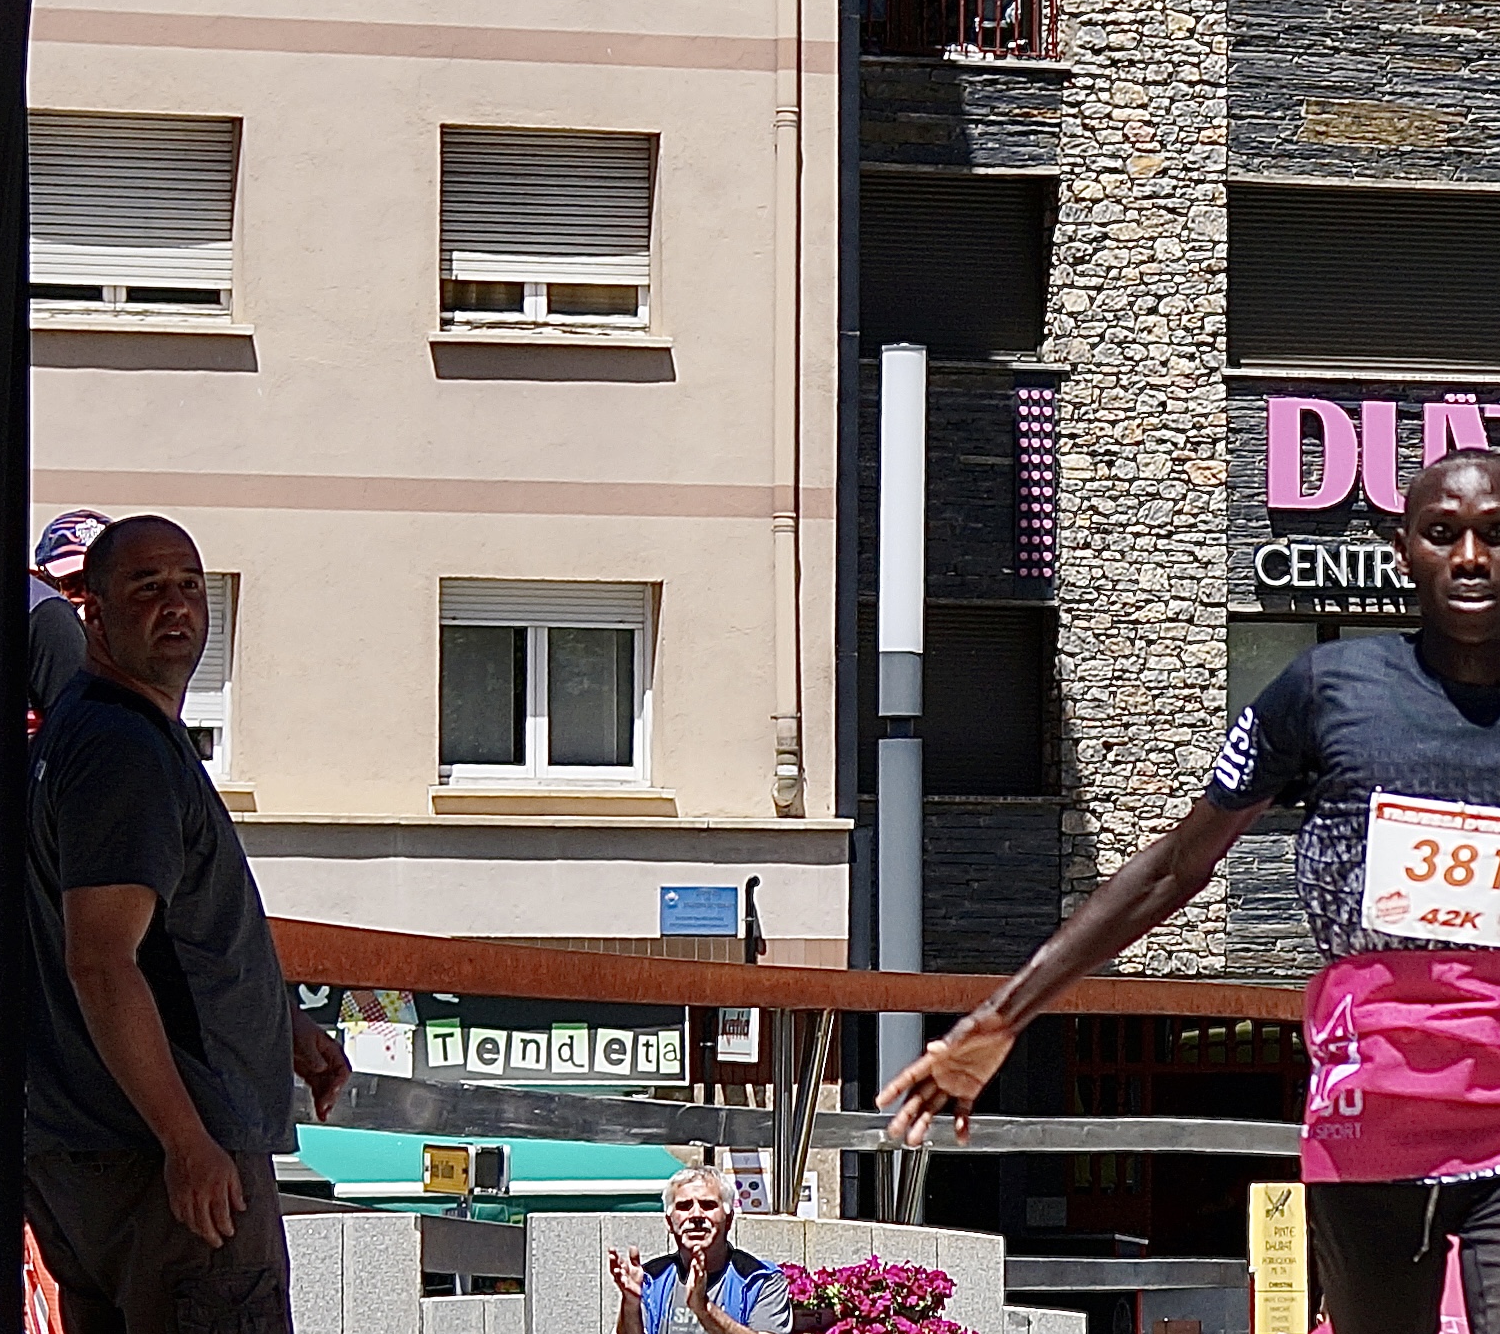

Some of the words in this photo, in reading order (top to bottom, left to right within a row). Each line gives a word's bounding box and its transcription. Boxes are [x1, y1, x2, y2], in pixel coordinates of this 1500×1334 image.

[1383, 806, 1464, 831] TRAVESSA
[1418, 908, 1486, 931] 42K
[433, 1031, 683, 1069] Tendeta
